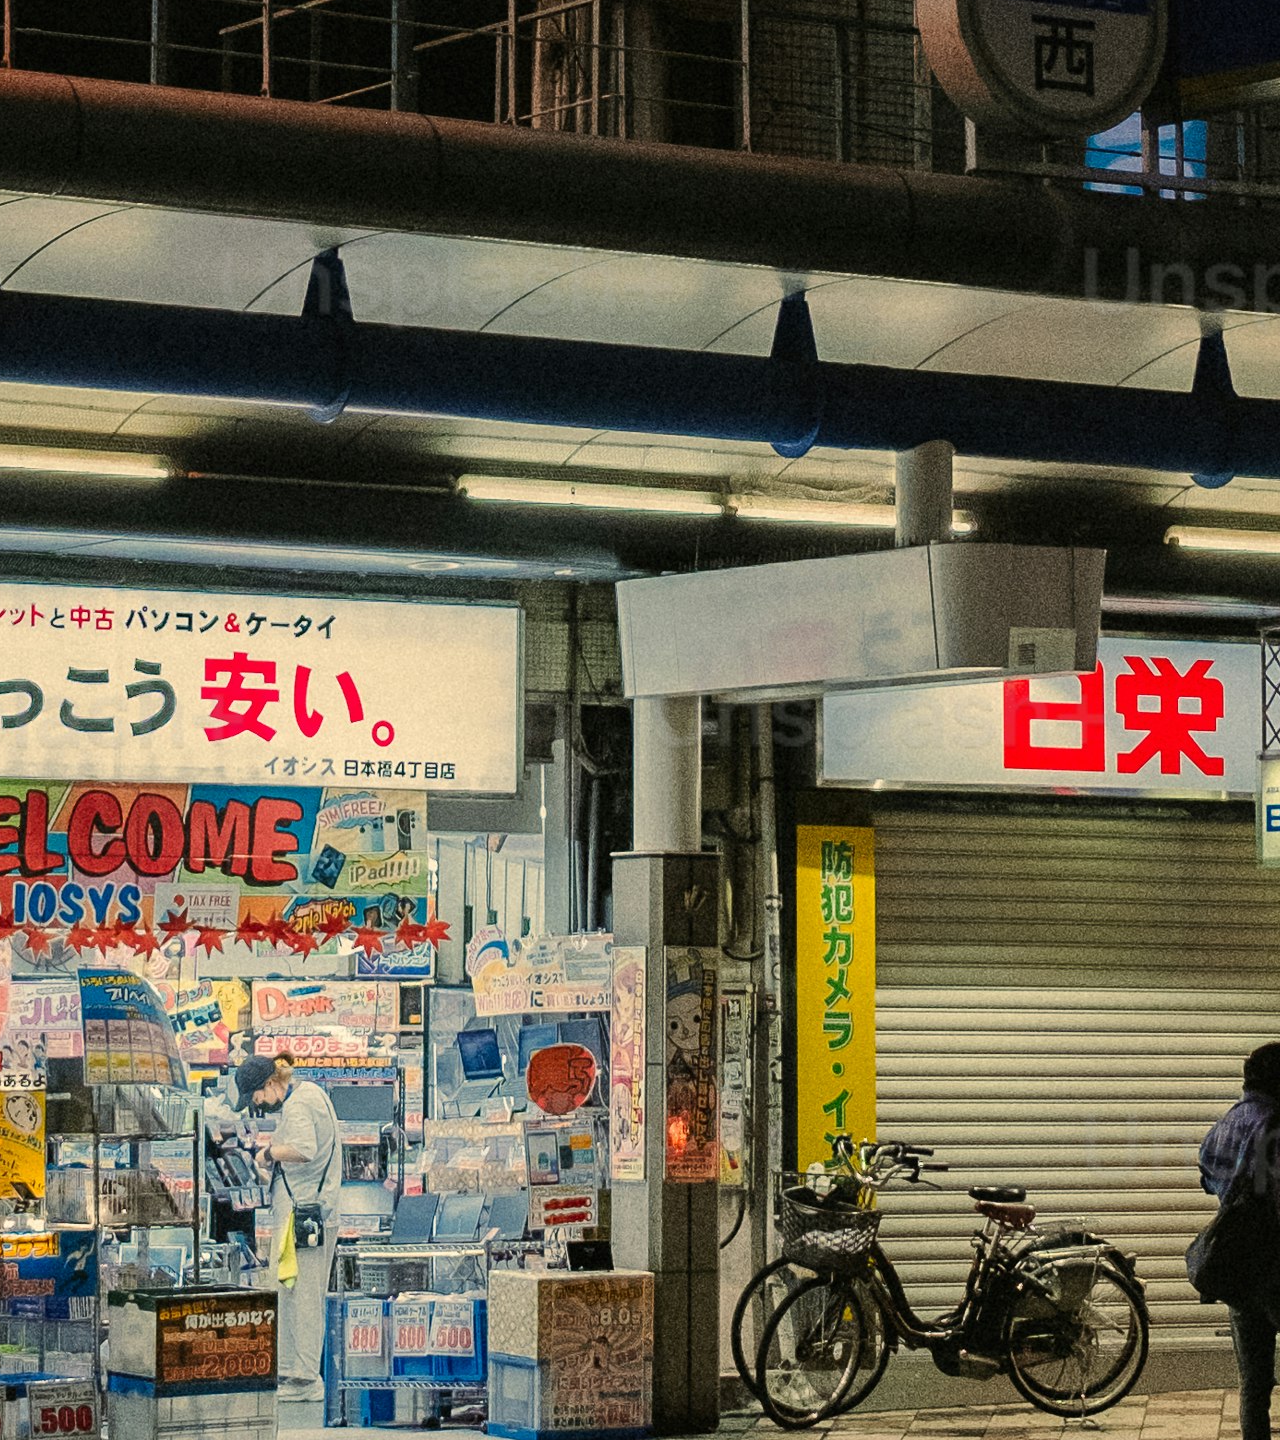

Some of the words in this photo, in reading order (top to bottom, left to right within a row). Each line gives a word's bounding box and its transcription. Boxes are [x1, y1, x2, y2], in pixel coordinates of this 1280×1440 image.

[1033, 13, 1096, 97] 西
[126, 606, 337, 640] パソコン&ケータイ
[199, 650, 395, 748] 安い。
[264, 755, 336, 777] イオシス
[343, 759, 456, 781] 日本橋4丁目店
[12, 882, 142, 926] IOSYS
[188, 895, 207, 908] TAX
[208, 894, 231, 908] FREE
[256, 986, 335, 1021] DRANK
[184, 1309, 276, 1331] 何が出るかな?
